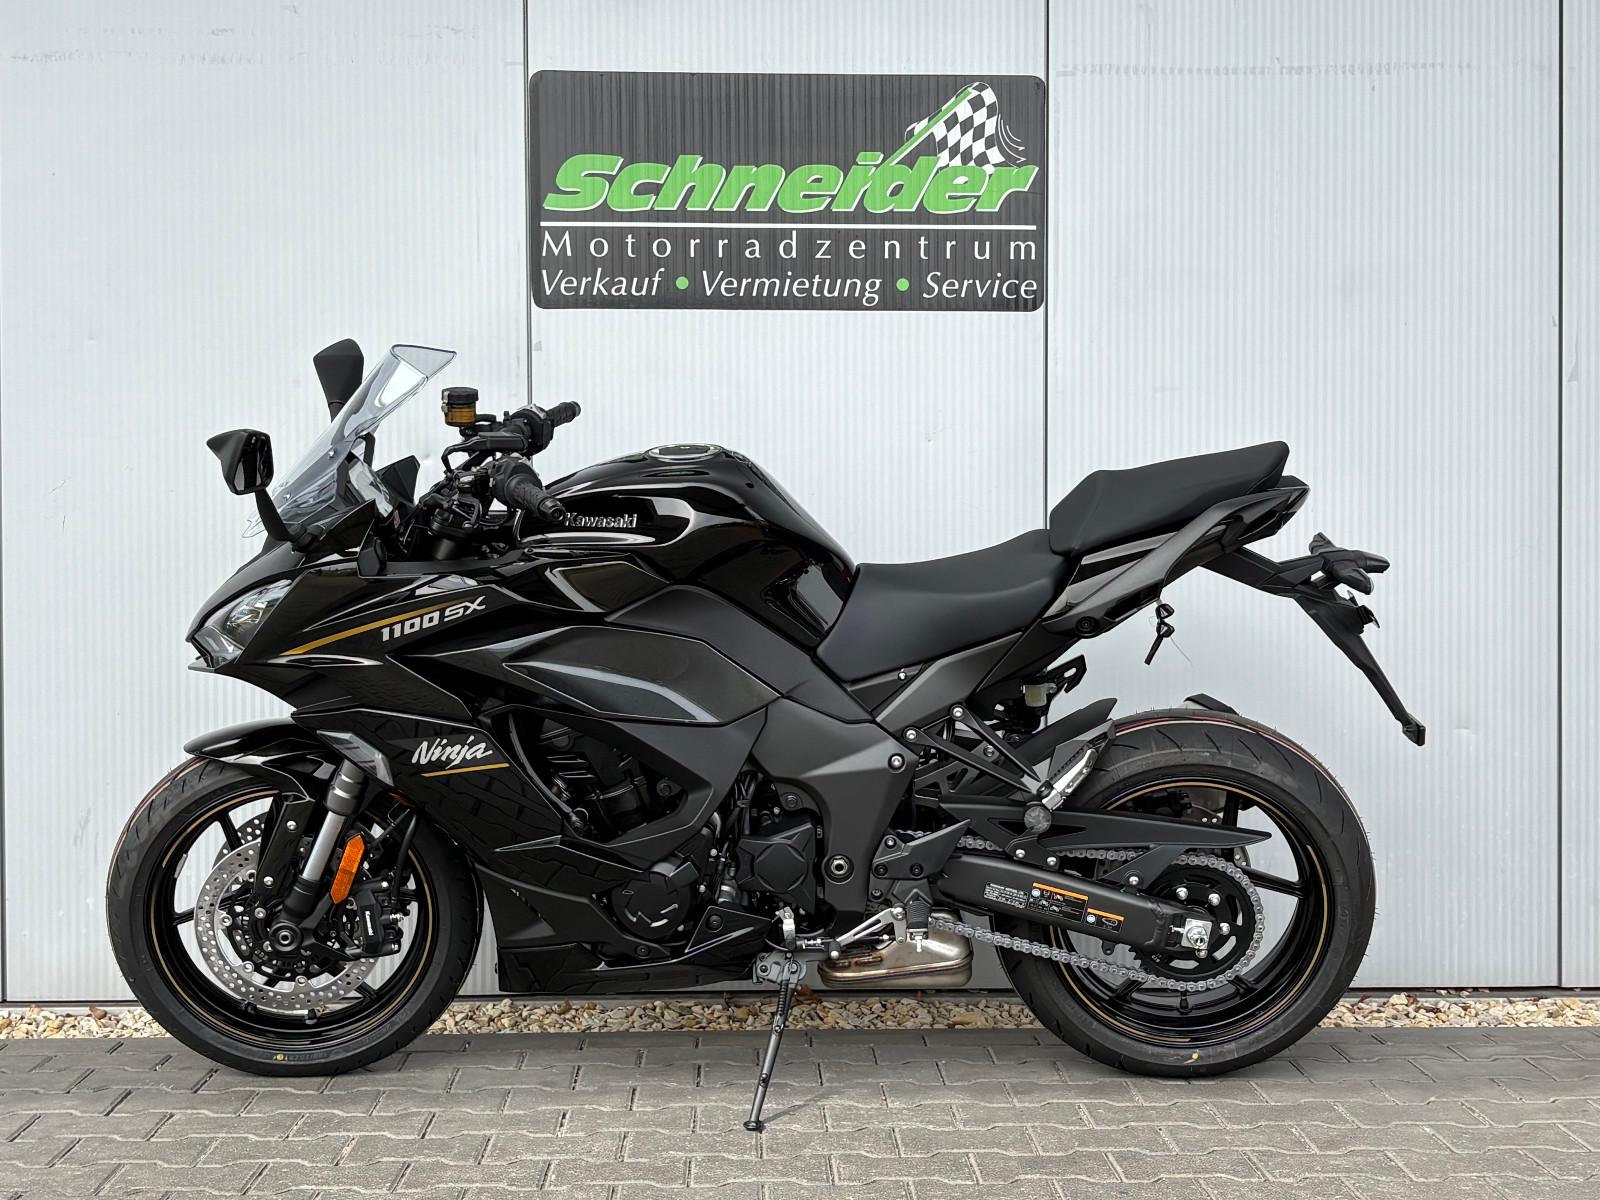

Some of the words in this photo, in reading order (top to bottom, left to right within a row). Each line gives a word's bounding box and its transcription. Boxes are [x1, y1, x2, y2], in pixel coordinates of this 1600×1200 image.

[542, 151, 1039, 214] Schneider
[541, 229, 1037, 260] Motorradzentrum
[541, 267, 665, 297] Verkauf
[702, 270, 882, 306] Vermietung
[922, 271, 1038, 299] Service
[563, 511, 638, 528] Kawasaki
[380, 611, 440, 642] 1100
[444, 595, 486, 622] SX
[411, 735, 493, 770] Ninja
